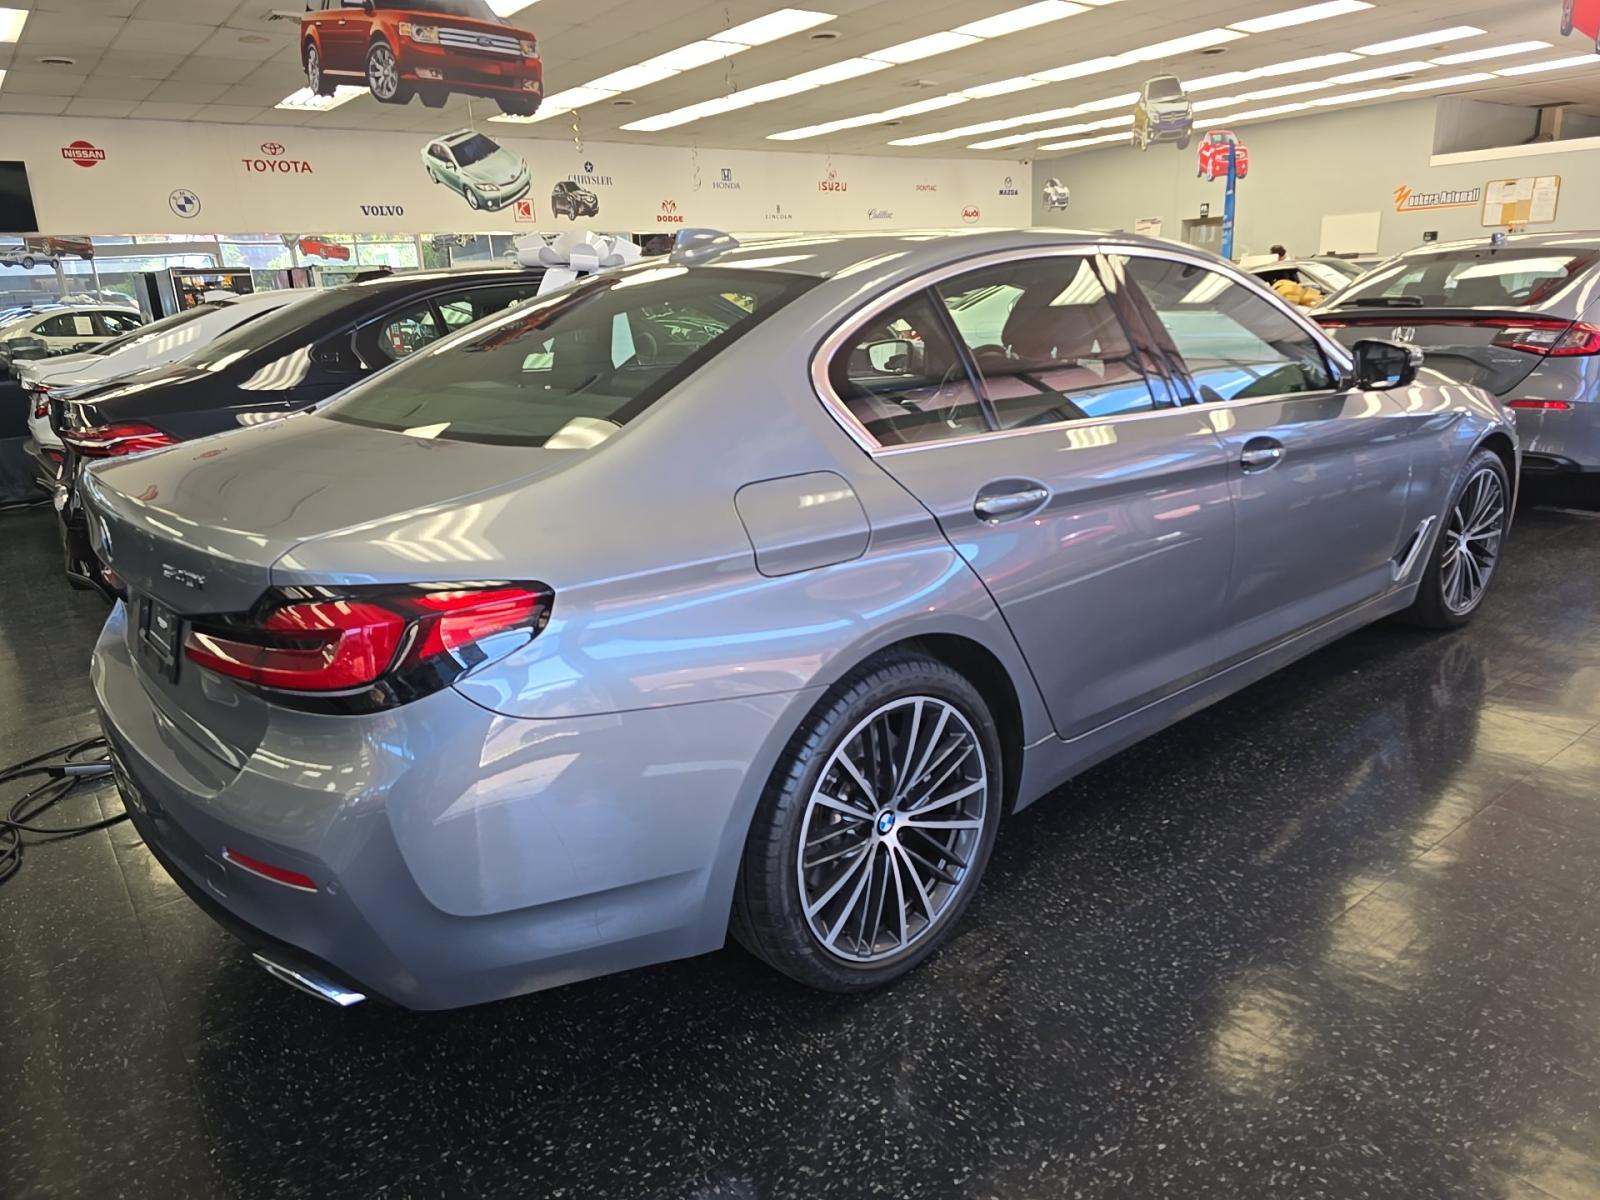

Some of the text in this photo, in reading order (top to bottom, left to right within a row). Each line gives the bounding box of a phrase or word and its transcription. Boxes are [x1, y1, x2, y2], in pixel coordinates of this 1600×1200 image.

[63, 149, 104, 159] NISSAN
[242, 159, 313, 173] TOYOTA
[712, 181, 741, 190] HONDA
[818, 180, 847, 192] ISUZU
[1440, 187, 1480, 204] Automall
[360, 205, 404, 216] VOLVO
[963, 208, 980, 217] Audi
[656, 215, 684, 223] DODGE
